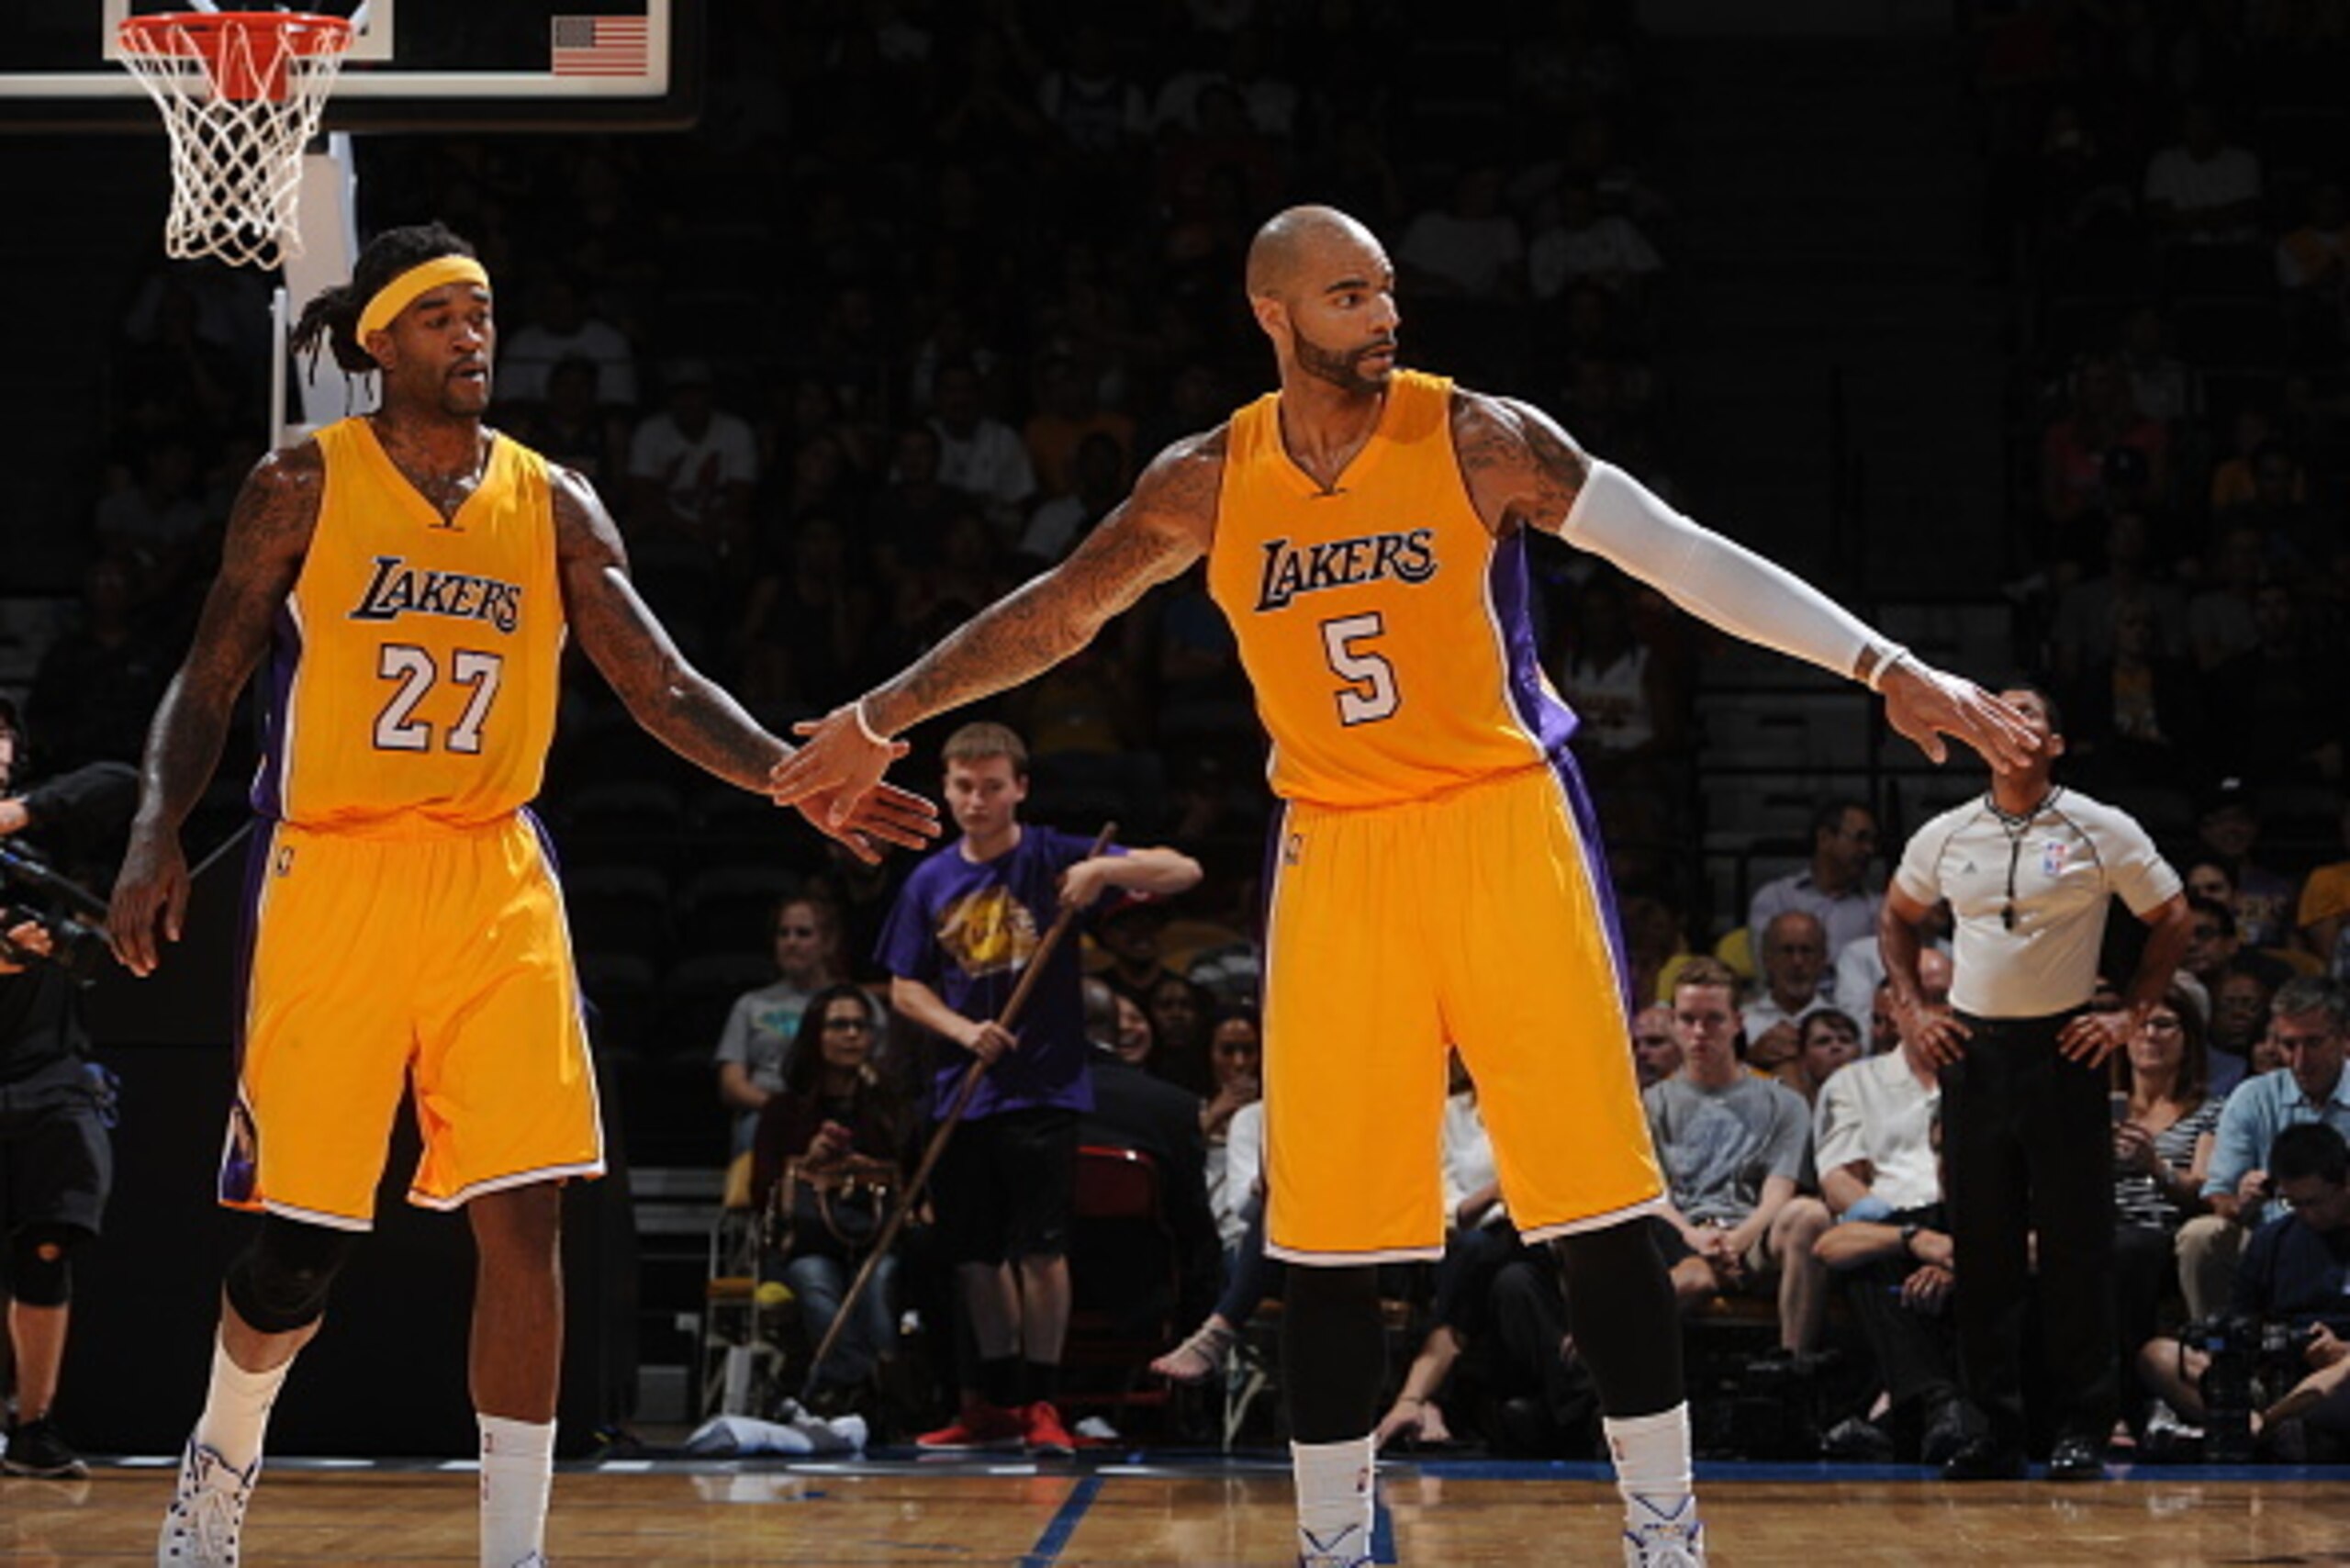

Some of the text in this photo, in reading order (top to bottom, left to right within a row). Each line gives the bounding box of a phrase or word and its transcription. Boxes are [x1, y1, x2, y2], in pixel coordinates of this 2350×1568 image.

[348, 555, 521, 633] LAKERS
[1253, 528, 1438, 612] LAKERS
[373, 643, 503, 755] 27
[1320, 610, 1401, 726] 5
